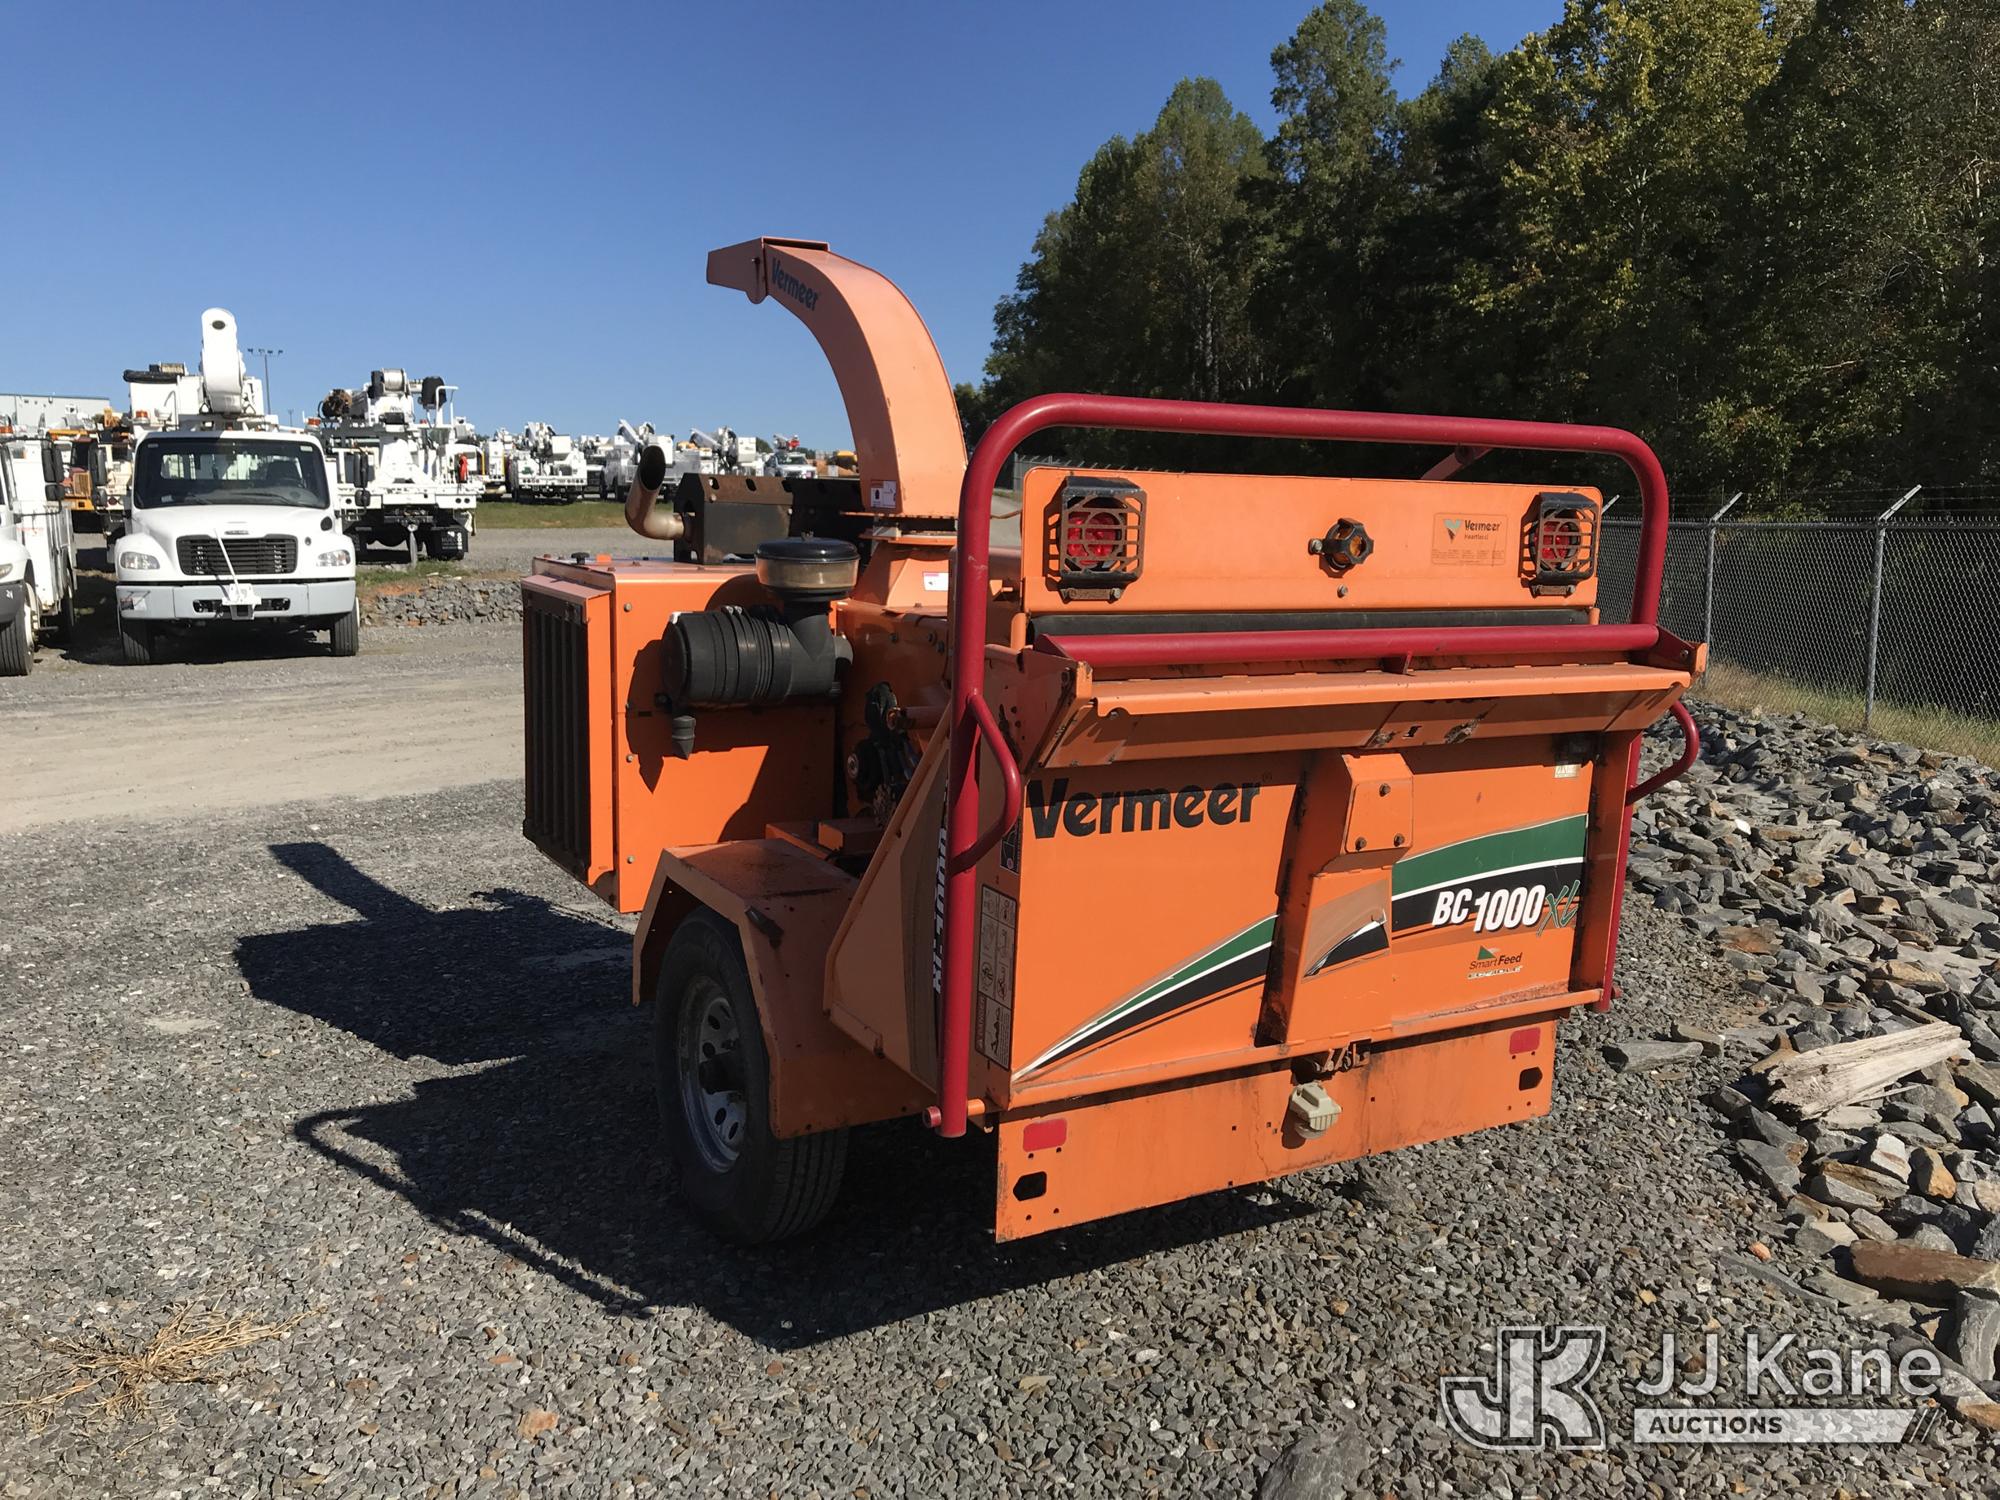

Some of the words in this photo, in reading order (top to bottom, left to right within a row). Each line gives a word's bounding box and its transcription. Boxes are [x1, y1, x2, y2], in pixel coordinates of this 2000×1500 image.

[772, 257, 818, 311] Vermeer
[1464, 519, 1501, 531] Vermeer
[1026, 778, 1261, 839] Vermeer
